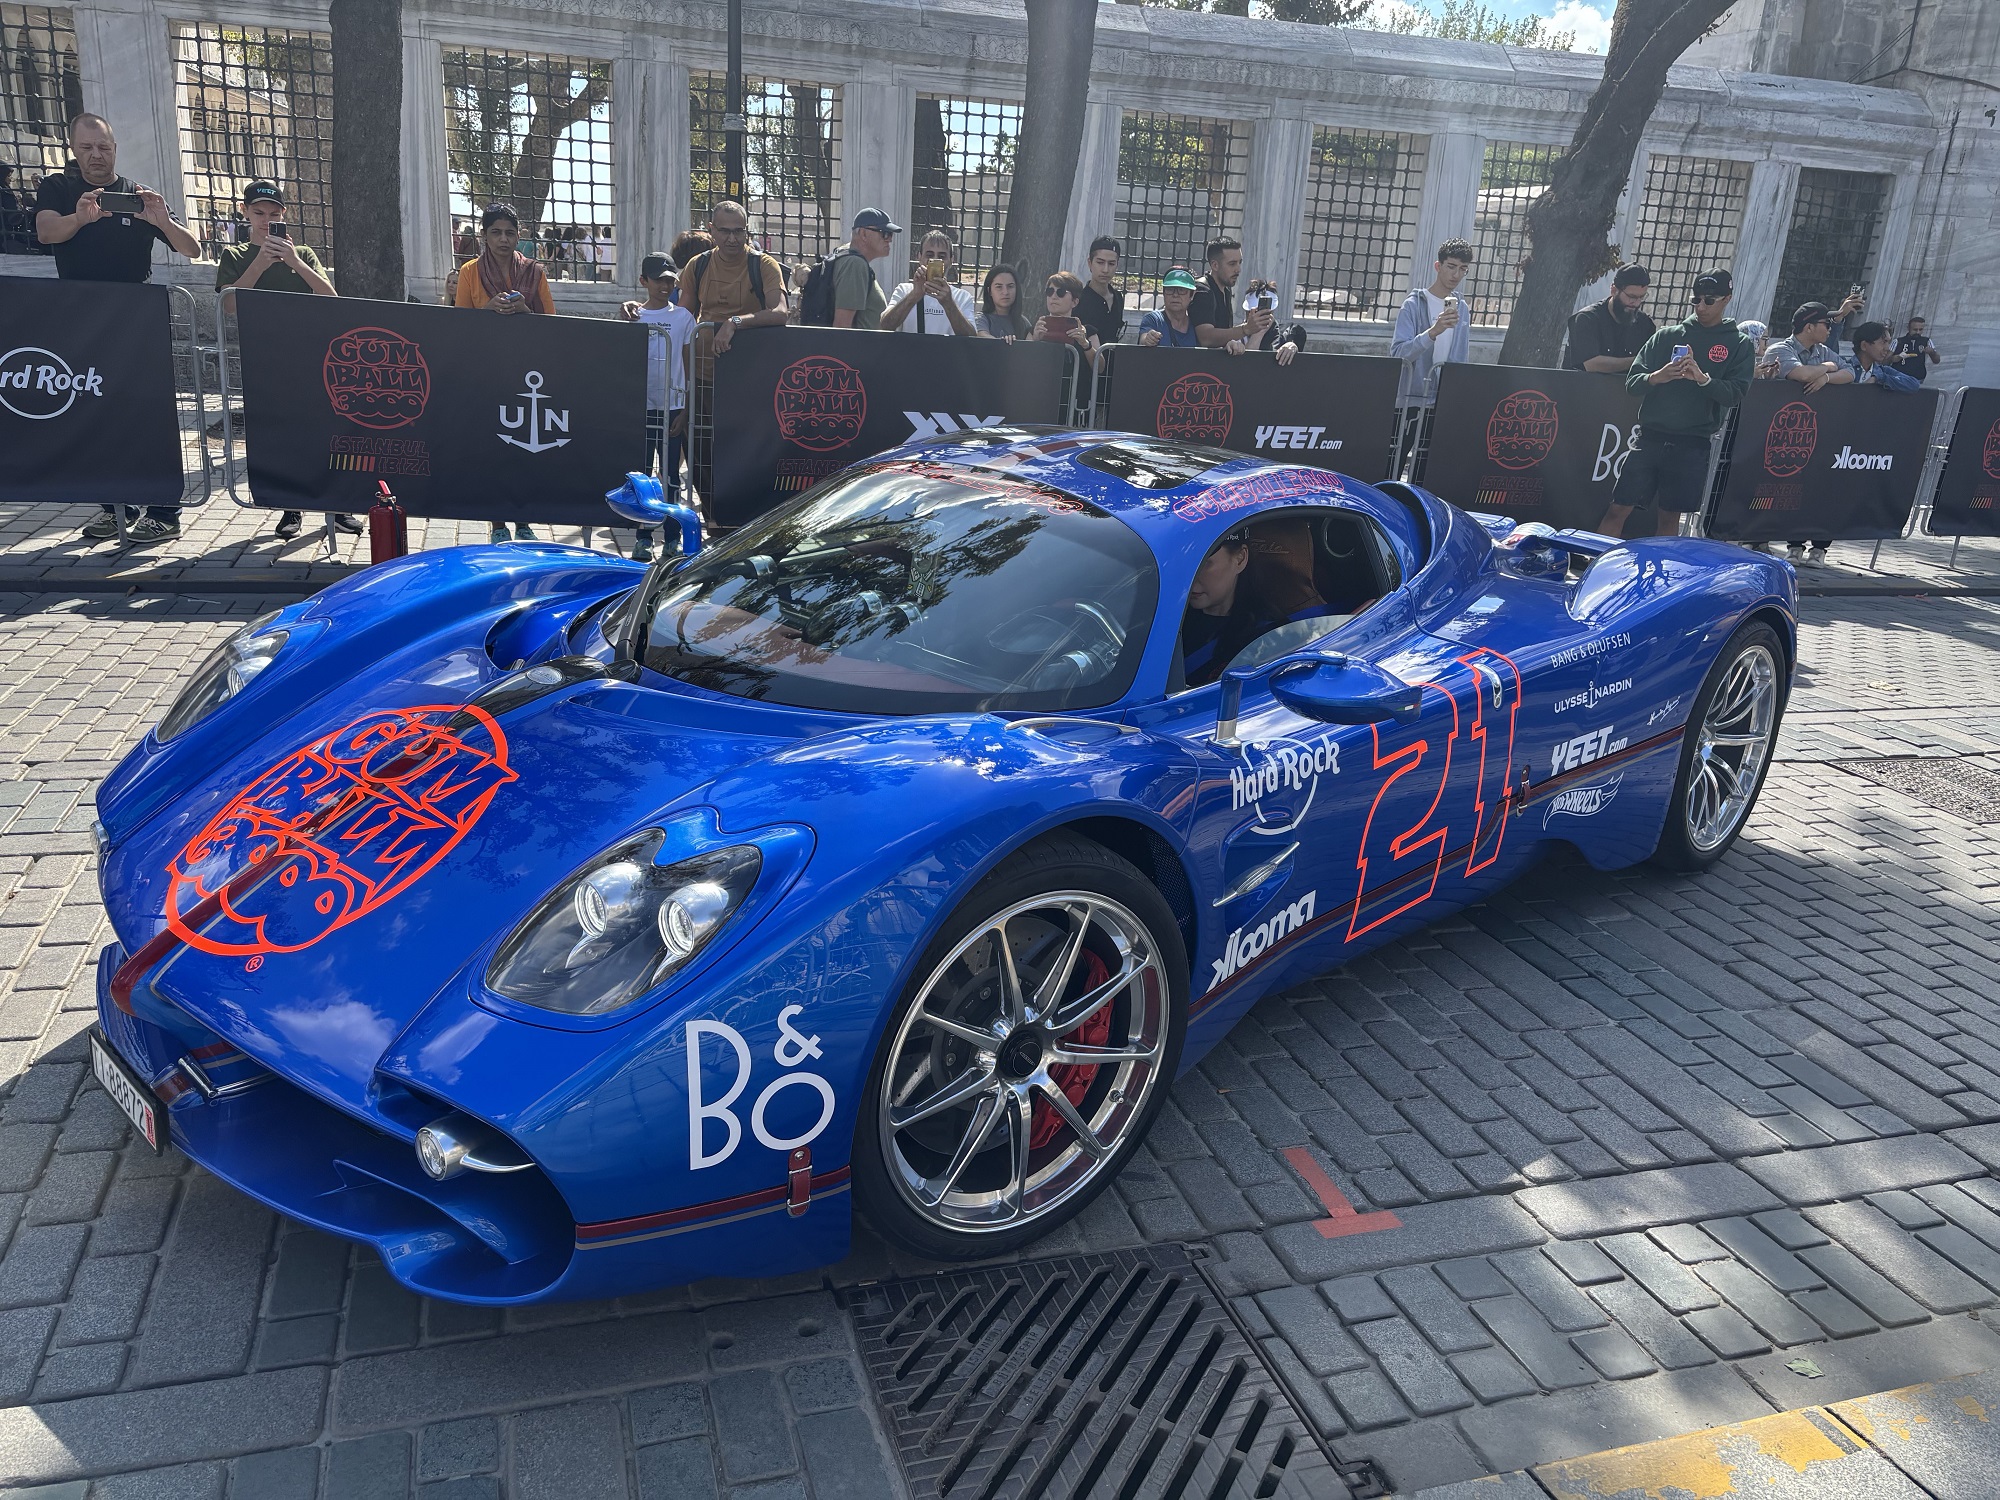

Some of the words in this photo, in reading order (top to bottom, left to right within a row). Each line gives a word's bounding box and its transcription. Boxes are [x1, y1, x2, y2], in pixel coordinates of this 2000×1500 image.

[329, 335, 420, 365] GUM
[36, 365, 103, 397] Rock
[330, 364, 425, 393] BALL
[781, 363, 861, 391] GUM
[331, 390, 424, 419] 3000
[780, 391, 861, 417] BALL
[1164, 380, 1231, 405] GUM
[1161, 405, 1228, 429] BALL
[1496, 398, 1557, 419] GUM
[1773, 409, 1817, 430] GUM
[780, 416, 861, 441] 3000
[1254, 425, 1343, 450] YEET.com
[1491, 419, 1553, 440] BALL
[1768, 429, 1815, 450] BALL
[330, 435, 430, 458] ISTANBUL
[1488, 439, 1549, 460] 3000
[1764, 448, 1811, 469] 3000
[378, 456, 431, 476] IBIZA
[1478, 475, 1544, 491] ISTANBUL
[1550, 647, 1578, 669] BANG
[1579, 645, 1587, 659] &
[1587, 632, 1631, 656] OLUFSEN
[1554, 692, 1588, 714] ULYSSE
[1594, 678, 1632, 698] NARDIN
[1551, 725, 1628, 776] YEET.com
[325, 711, 519, 830] GUM
[1229, 753, 1278, 811] Hard
[1277, 734, 1340, 790] Rock
[1344, 647, 1521, 943] 21
[229, 748, 445, 906] BALL
